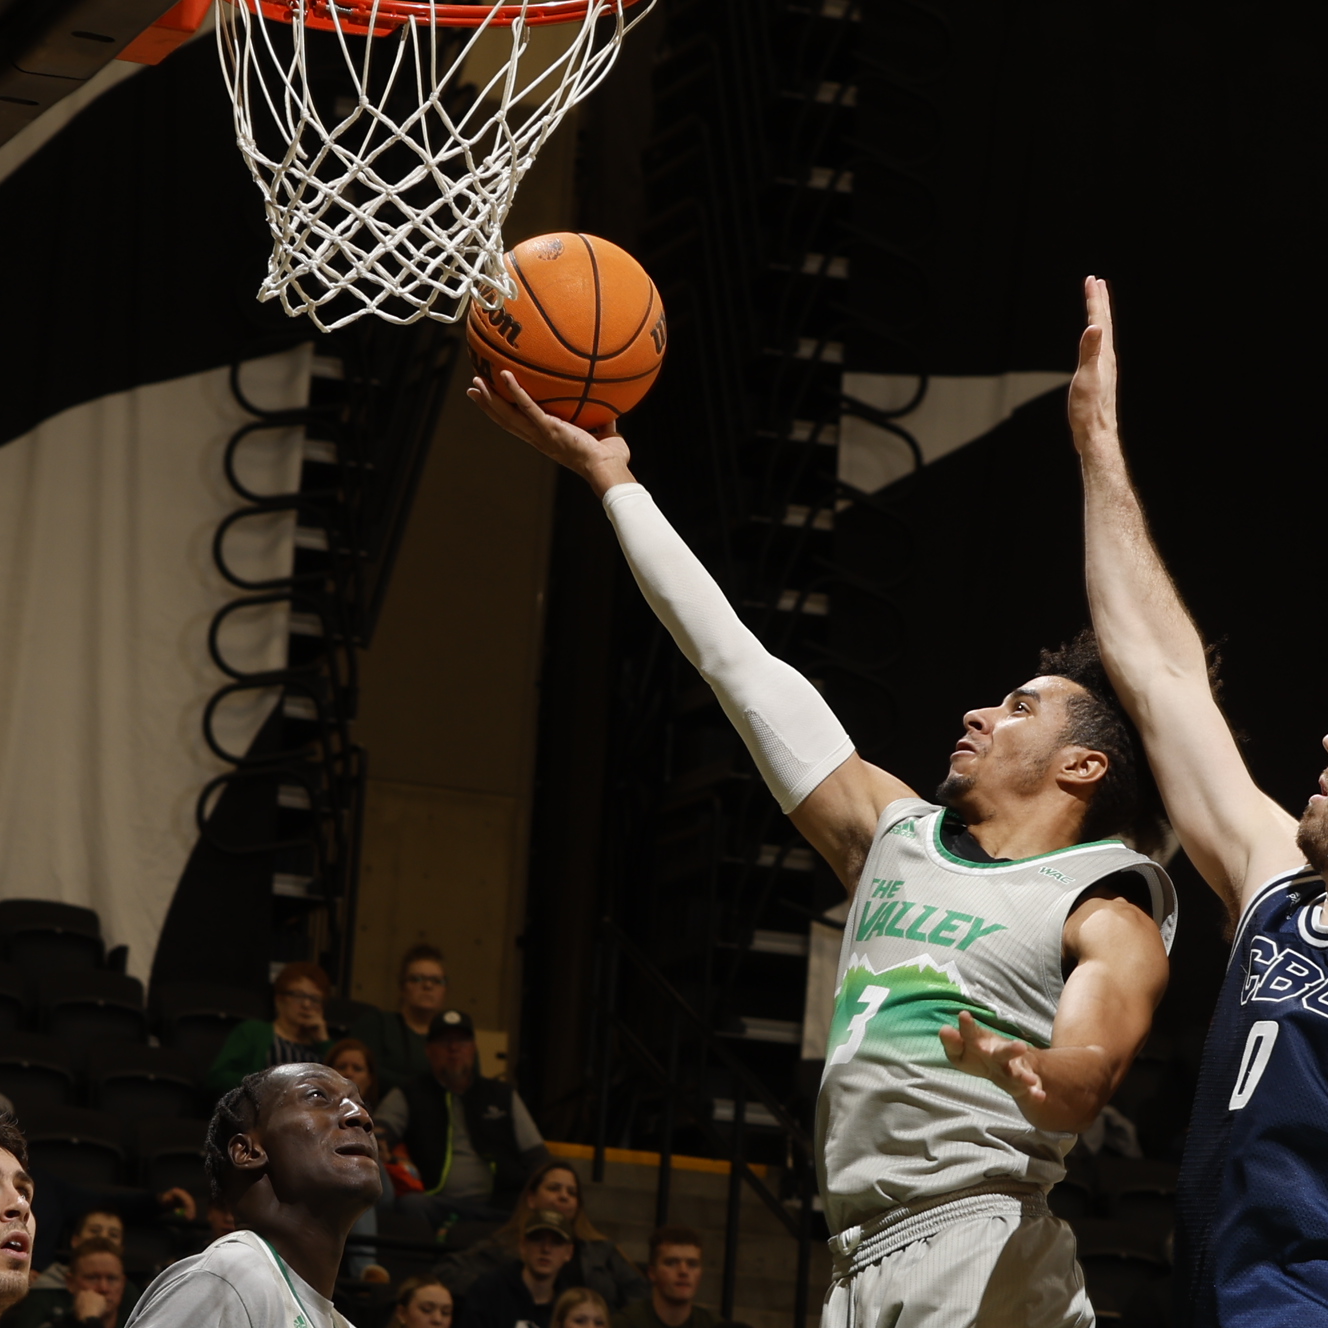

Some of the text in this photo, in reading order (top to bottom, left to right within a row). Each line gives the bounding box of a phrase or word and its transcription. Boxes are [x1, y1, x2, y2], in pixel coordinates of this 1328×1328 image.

[872, 878, 904, 899] THE
[1039, 866, 1074, 884] WAC
[856, 900, 1008, 951] VALLEY
[830, 984, 890, 1066] 3
[1228, 1020, 1279, 1111] 0
